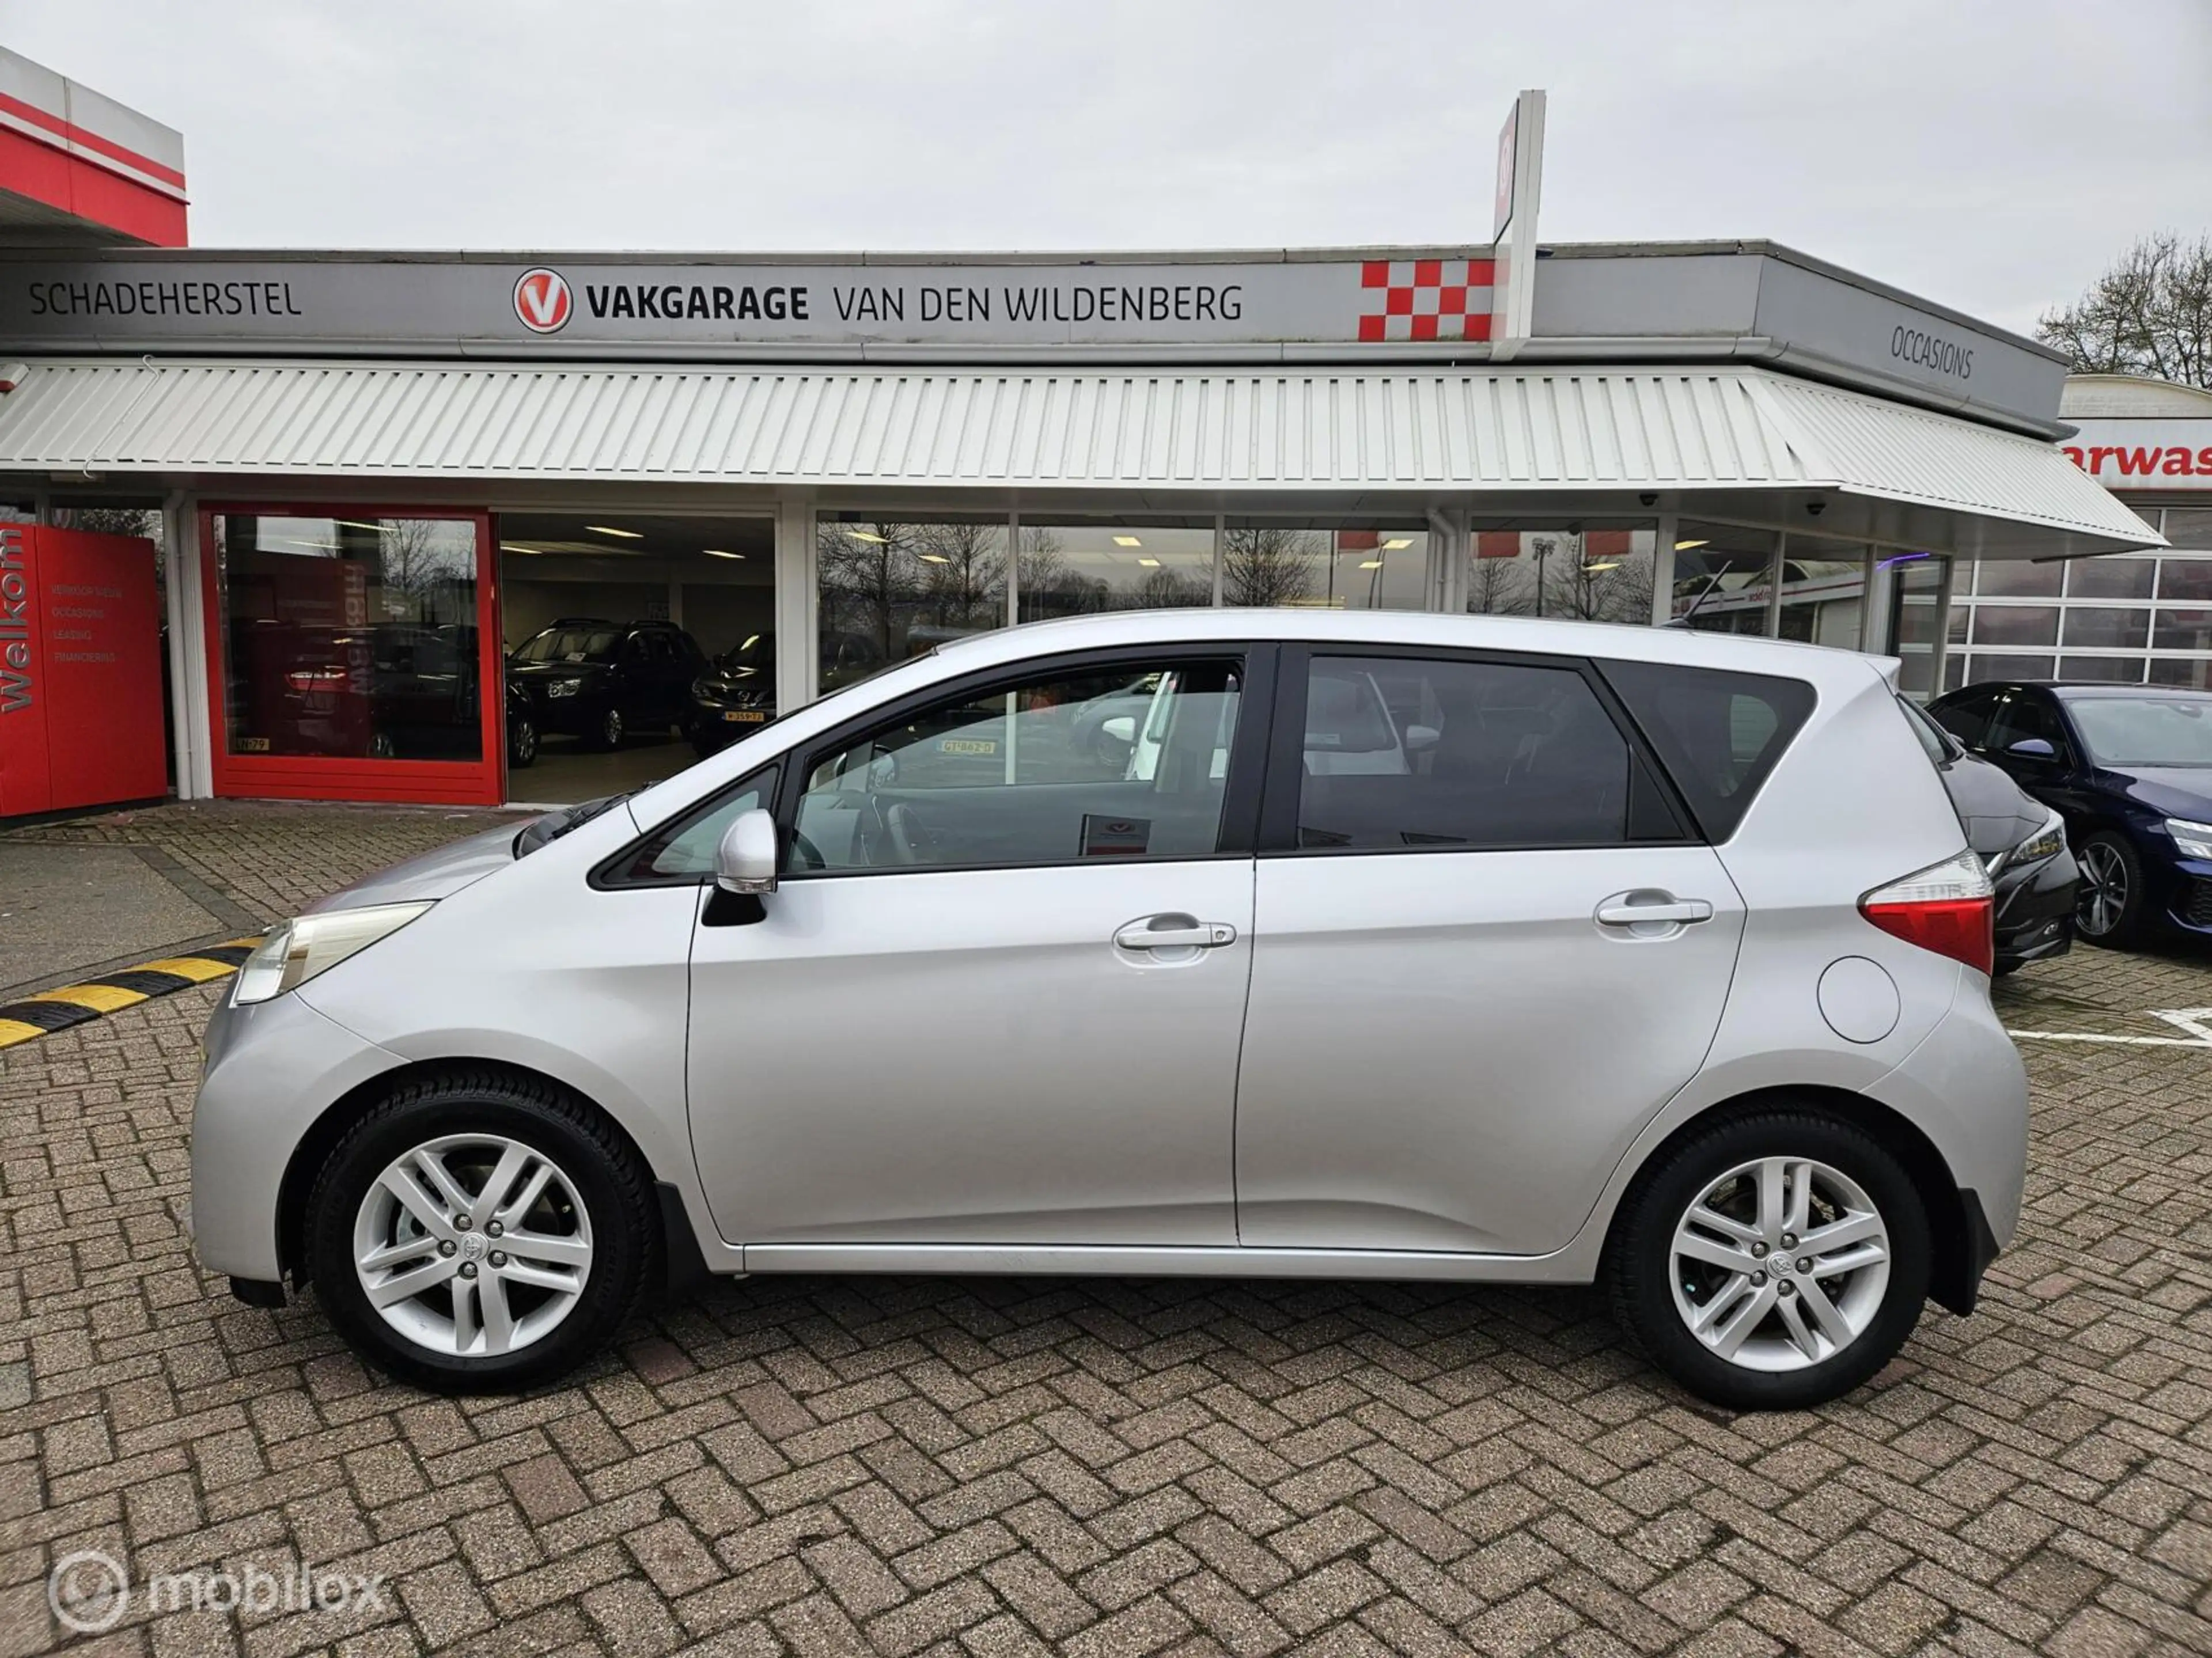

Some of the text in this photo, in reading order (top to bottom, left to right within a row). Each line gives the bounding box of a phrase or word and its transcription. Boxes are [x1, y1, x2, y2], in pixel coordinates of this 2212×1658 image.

[29, 282, 302, 315] SCHADEHERSTEL
[586, 284, 1242, 321] VAKGARAGE VAN DEN WILDENBERG
[1892, 325, 1974, 380] OCCASIONS
[0, 528, 32, 714] Welkom
